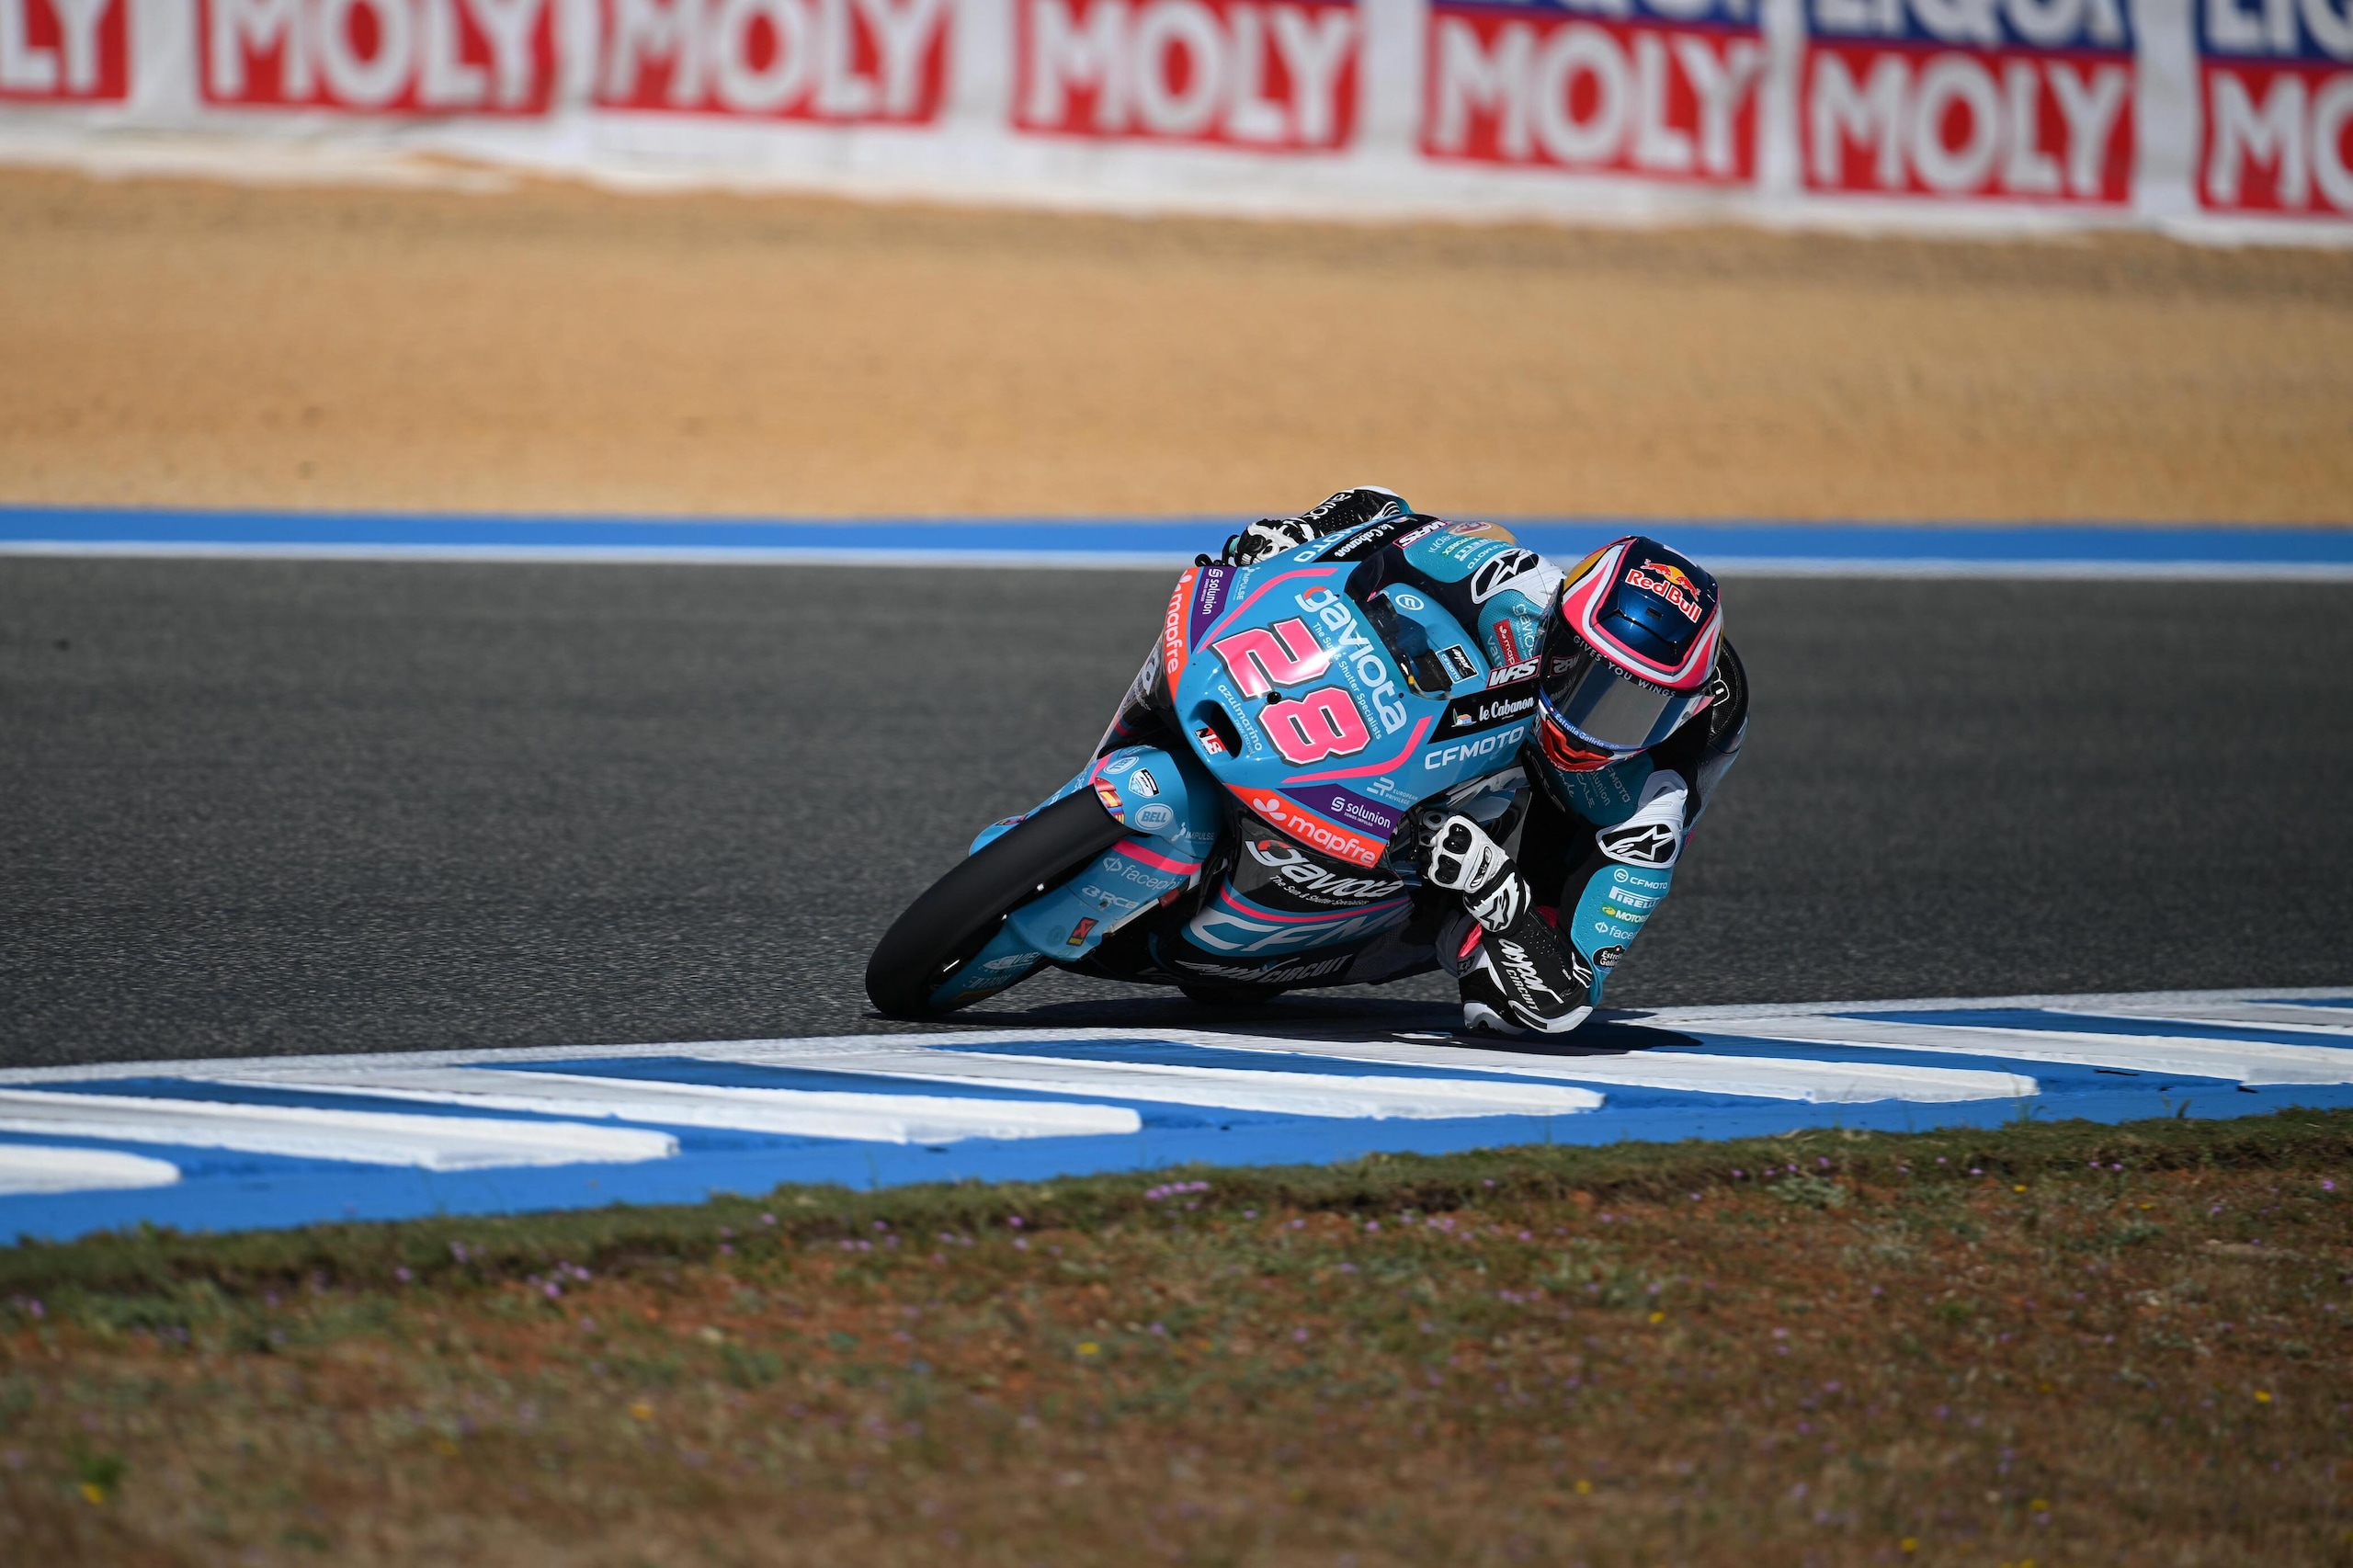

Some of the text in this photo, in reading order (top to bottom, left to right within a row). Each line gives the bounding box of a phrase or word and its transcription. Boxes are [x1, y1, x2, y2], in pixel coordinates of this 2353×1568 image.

[0, 0, 103, 90] LY
[206, 0, 551, 108] MOLY
[605, 0, 936, 116] MOLY
[1024, 0, 1353, 142] MOLY
[1432, 17, 1765, 173] MOLY
[1811, 50, 2129, 197] MOLY
[2206, 68, 2353, 208] MO
[1334, 528, 1384, 558] Cabanon
[1398, 520, 1447, 549] WRS
[1202, 578, 1221, 615] solunion
[1236, 572, 1251, 601] IMPULSE
[1625, 568, 1703, 624] Red Bull
[1165, 592, 1183, 675] mapfre
[1501, 638, 1517, 665] map
[1294, 585, 1407, 735] gaviota
[1440, 653, 1461, 681] CFMOTO
[1487, 658, 1540, 687] WRS
[1573, 634, 1677, 699] GIVES YOU WINGS
[1207, 613, 1372, 768] 28
[1313, 621, 1324, 638] The
[1338, 660, 1360, 693] Shutter
[1357, 692, 1381, 741] Specialists
[1217, 684, 1263, 752] azulmarino
[1478, 696, 1535, 722] le Cabanon
[1425, 725, 1525, 770] CFMOTO
[1554, 712, 1581, 737] Estrella
[1578, 731, 1605, 748] Galicia
[1385, 792, 1412, 806] PRIVILEGE
[1392, 788, 1419, 801] EUROPEAN
[1590, 769, 1610, 807] olunion
[1606, 767, 1631, 803] FMOTO
[1141, 811, 1167, 824] BELL
[1345, 801, 1392, 829] solunion
[1185, 831, 1215, 841] IMPULSE
[1287, 814, 1376, 865] mapfre
[1120, 864, 1183, 892] facephi
[1245, 839, 1404, 899] gaviota
[1268, 874, 1285, 888] The
[1284, 883, 1300, 897] Sun
[1630, 876, 1668, 891] CFMOTO
[1609, 926, 1637, 941] face
[1257, 953, 1354, 983] CIRCUIT
[1506, 967, 1540, 1012] CIRCUIT
